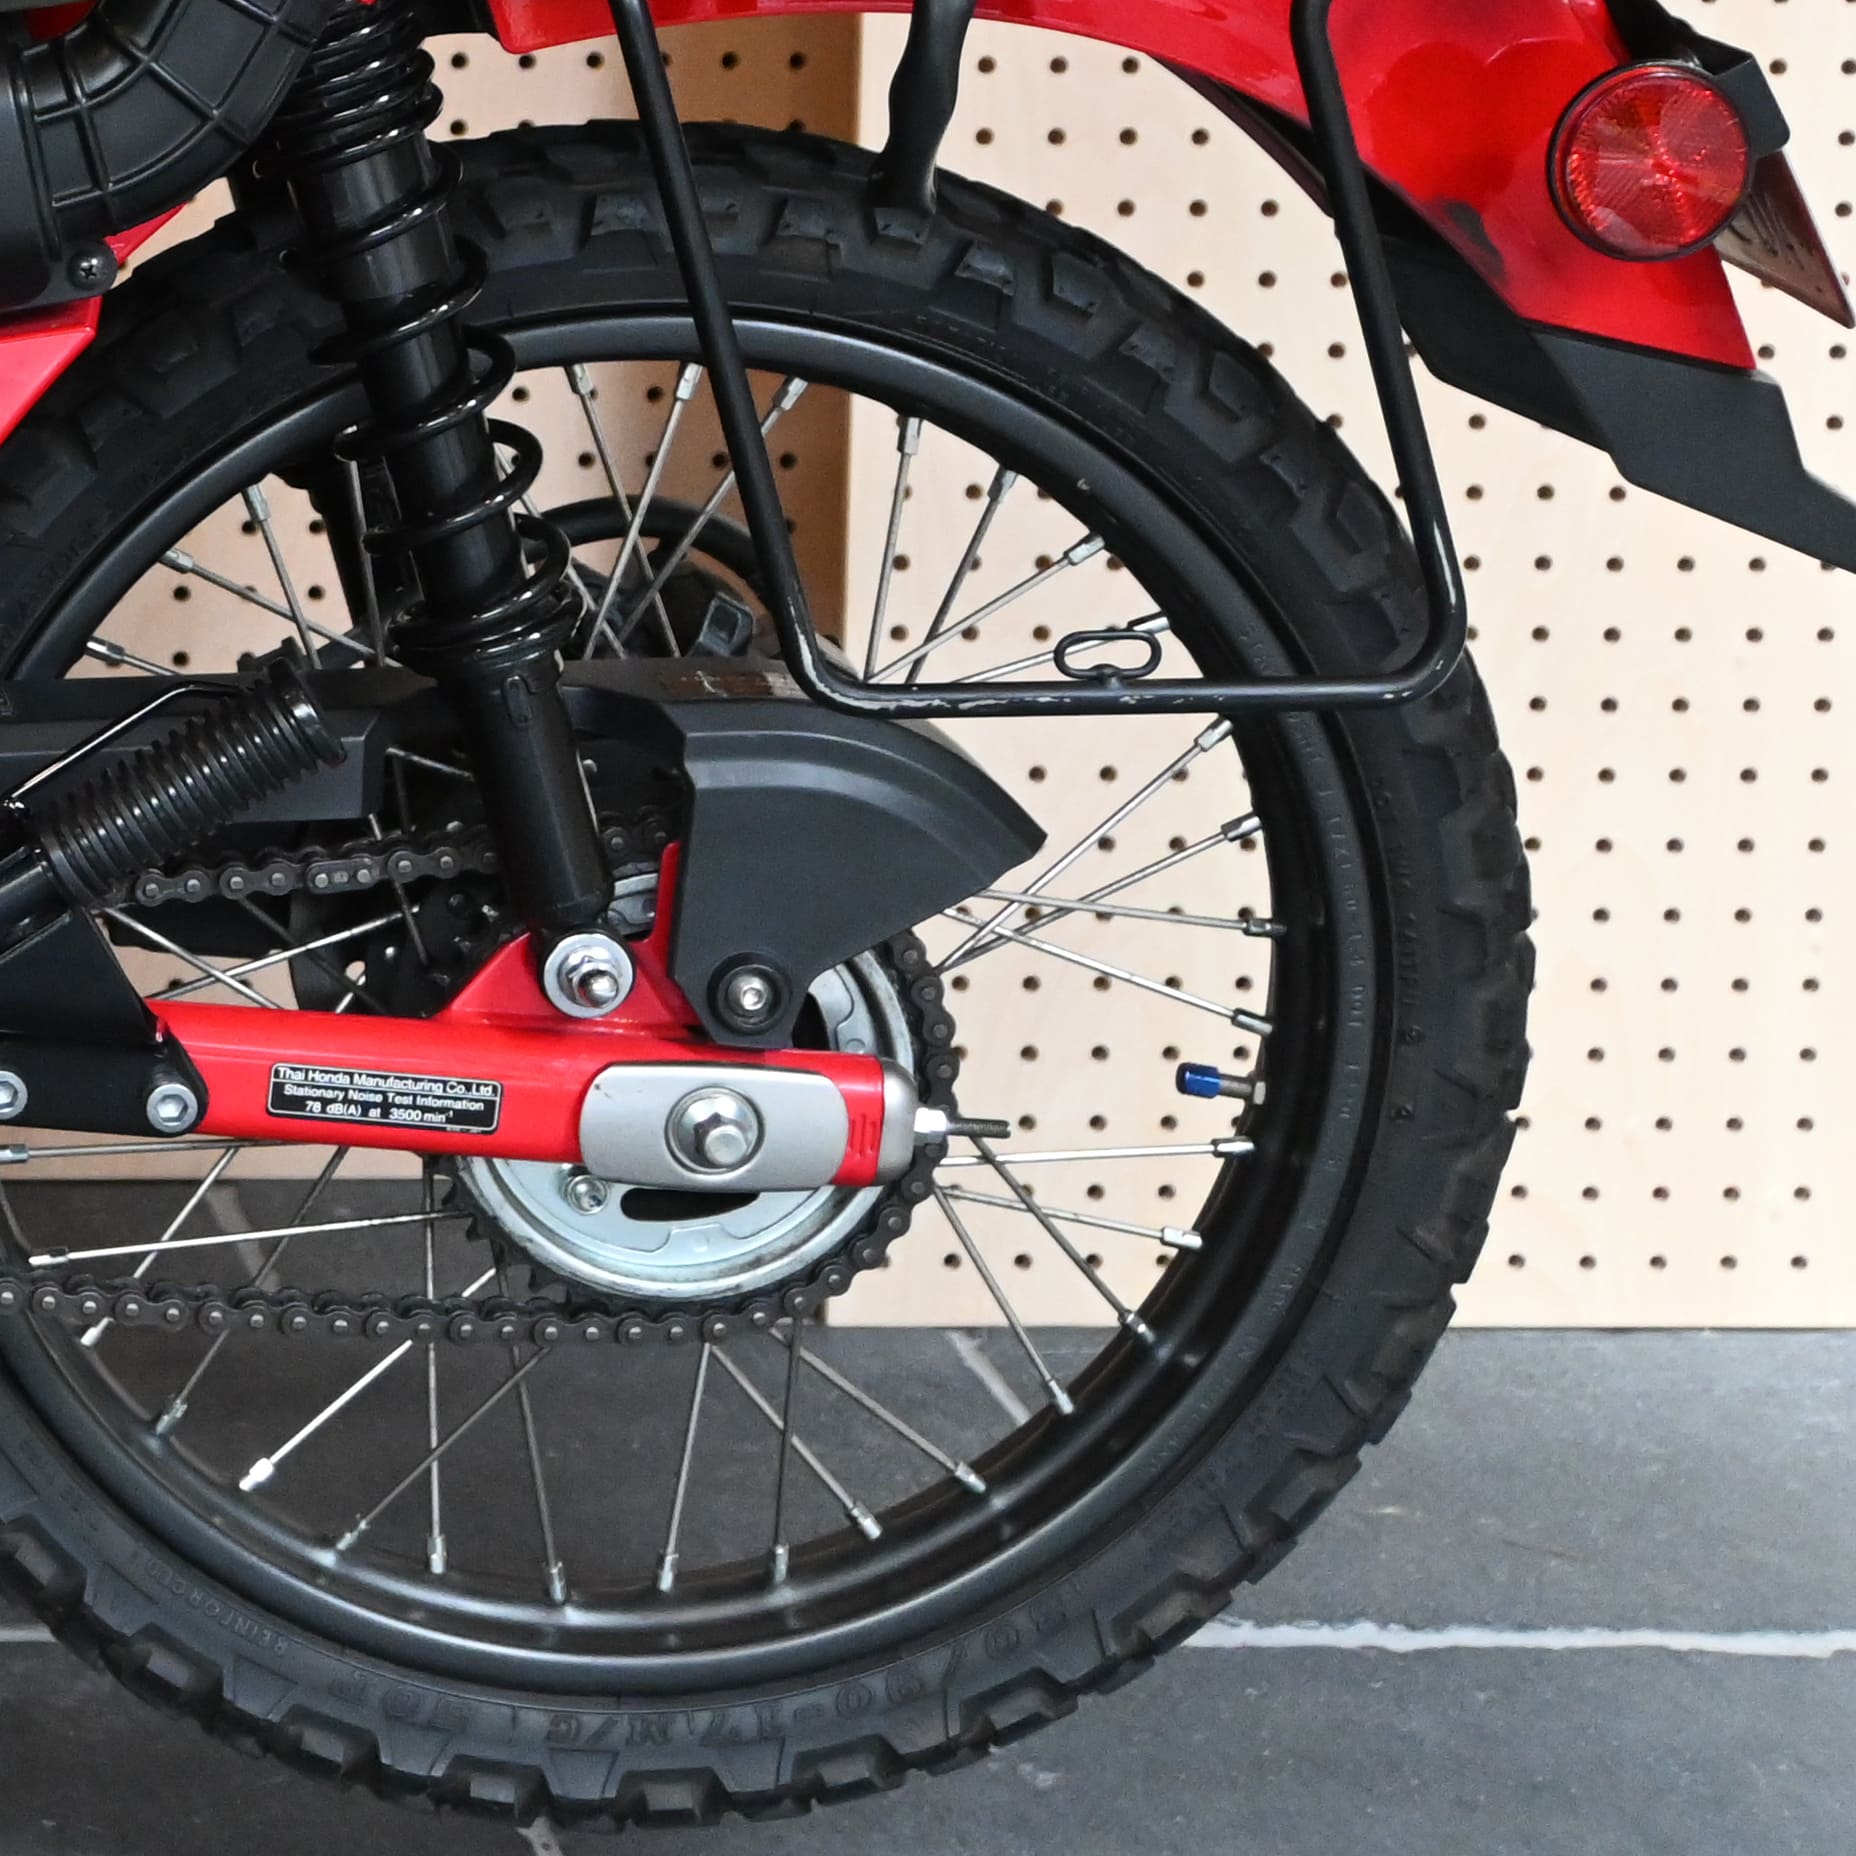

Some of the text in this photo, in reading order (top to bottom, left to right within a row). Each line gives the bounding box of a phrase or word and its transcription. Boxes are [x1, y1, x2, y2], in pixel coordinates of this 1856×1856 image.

[278, 1066, 306, 1082] Thai
[308, 1070, 350, 1085] Honda
[352, 1073, 444, 1095] Manufacturing
[284, 1084, 485, 1112] Stationary Noise Test Information
[304, 1100, 322, 1113] 78
[325, 1102, 362, 1118] dB(A)
[368, 1105, 382, 1119] at
[388, 1107, 422, 1122] 3500
